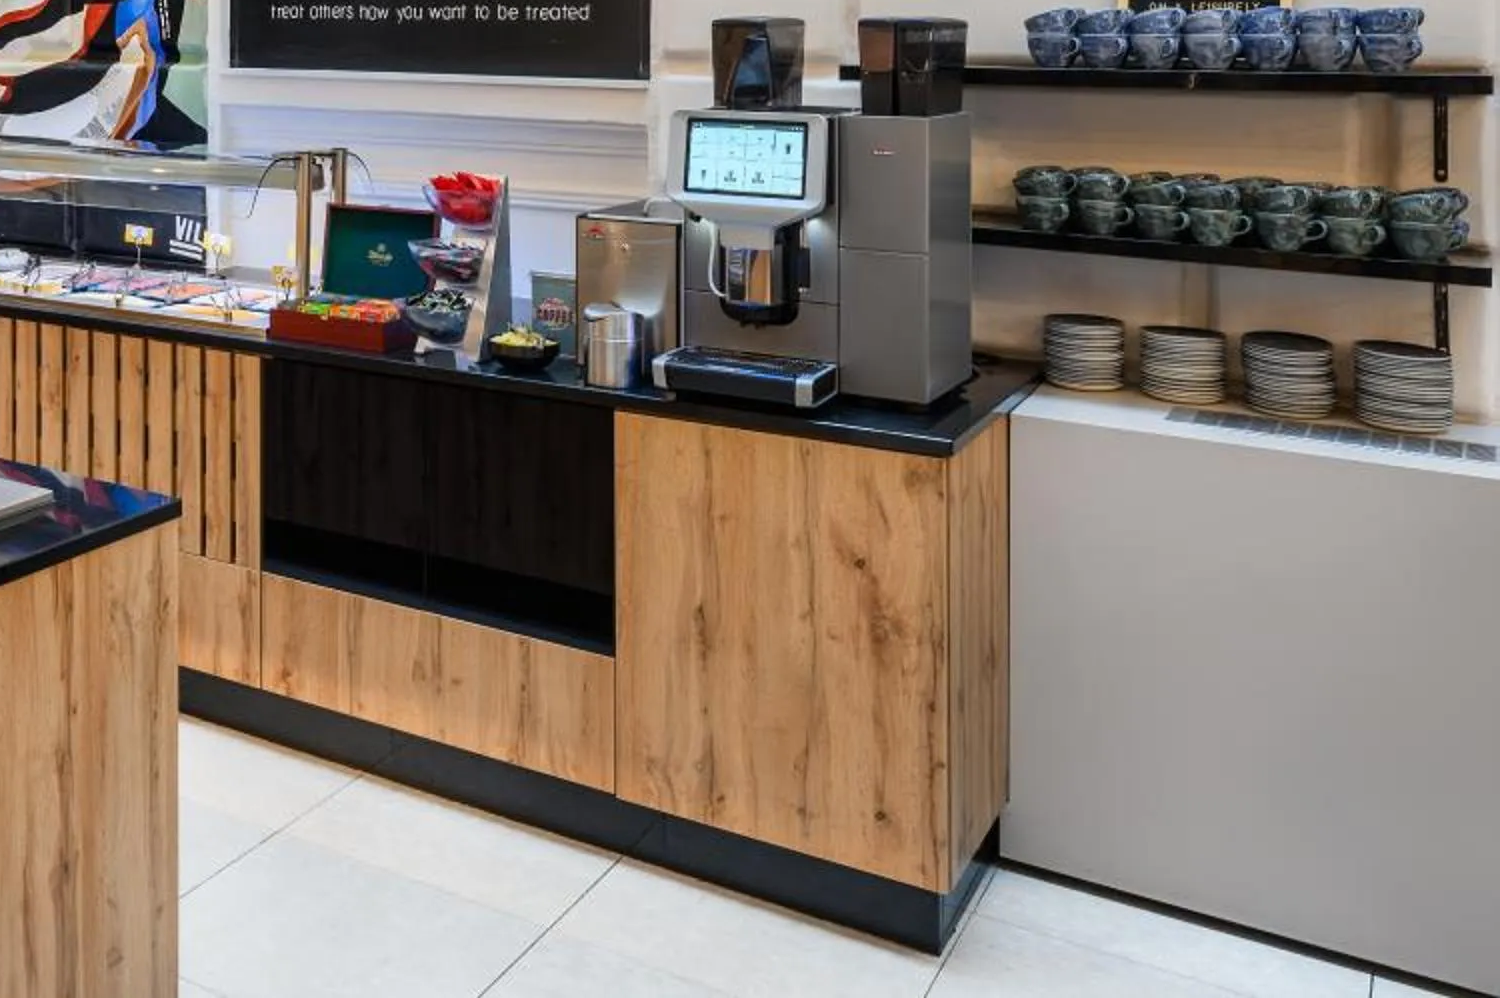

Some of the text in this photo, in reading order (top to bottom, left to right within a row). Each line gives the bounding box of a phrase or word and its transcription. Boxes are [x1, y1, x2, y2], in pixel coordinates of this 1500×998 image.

[272, 3, 590, 25] treat others how you want to be treated
